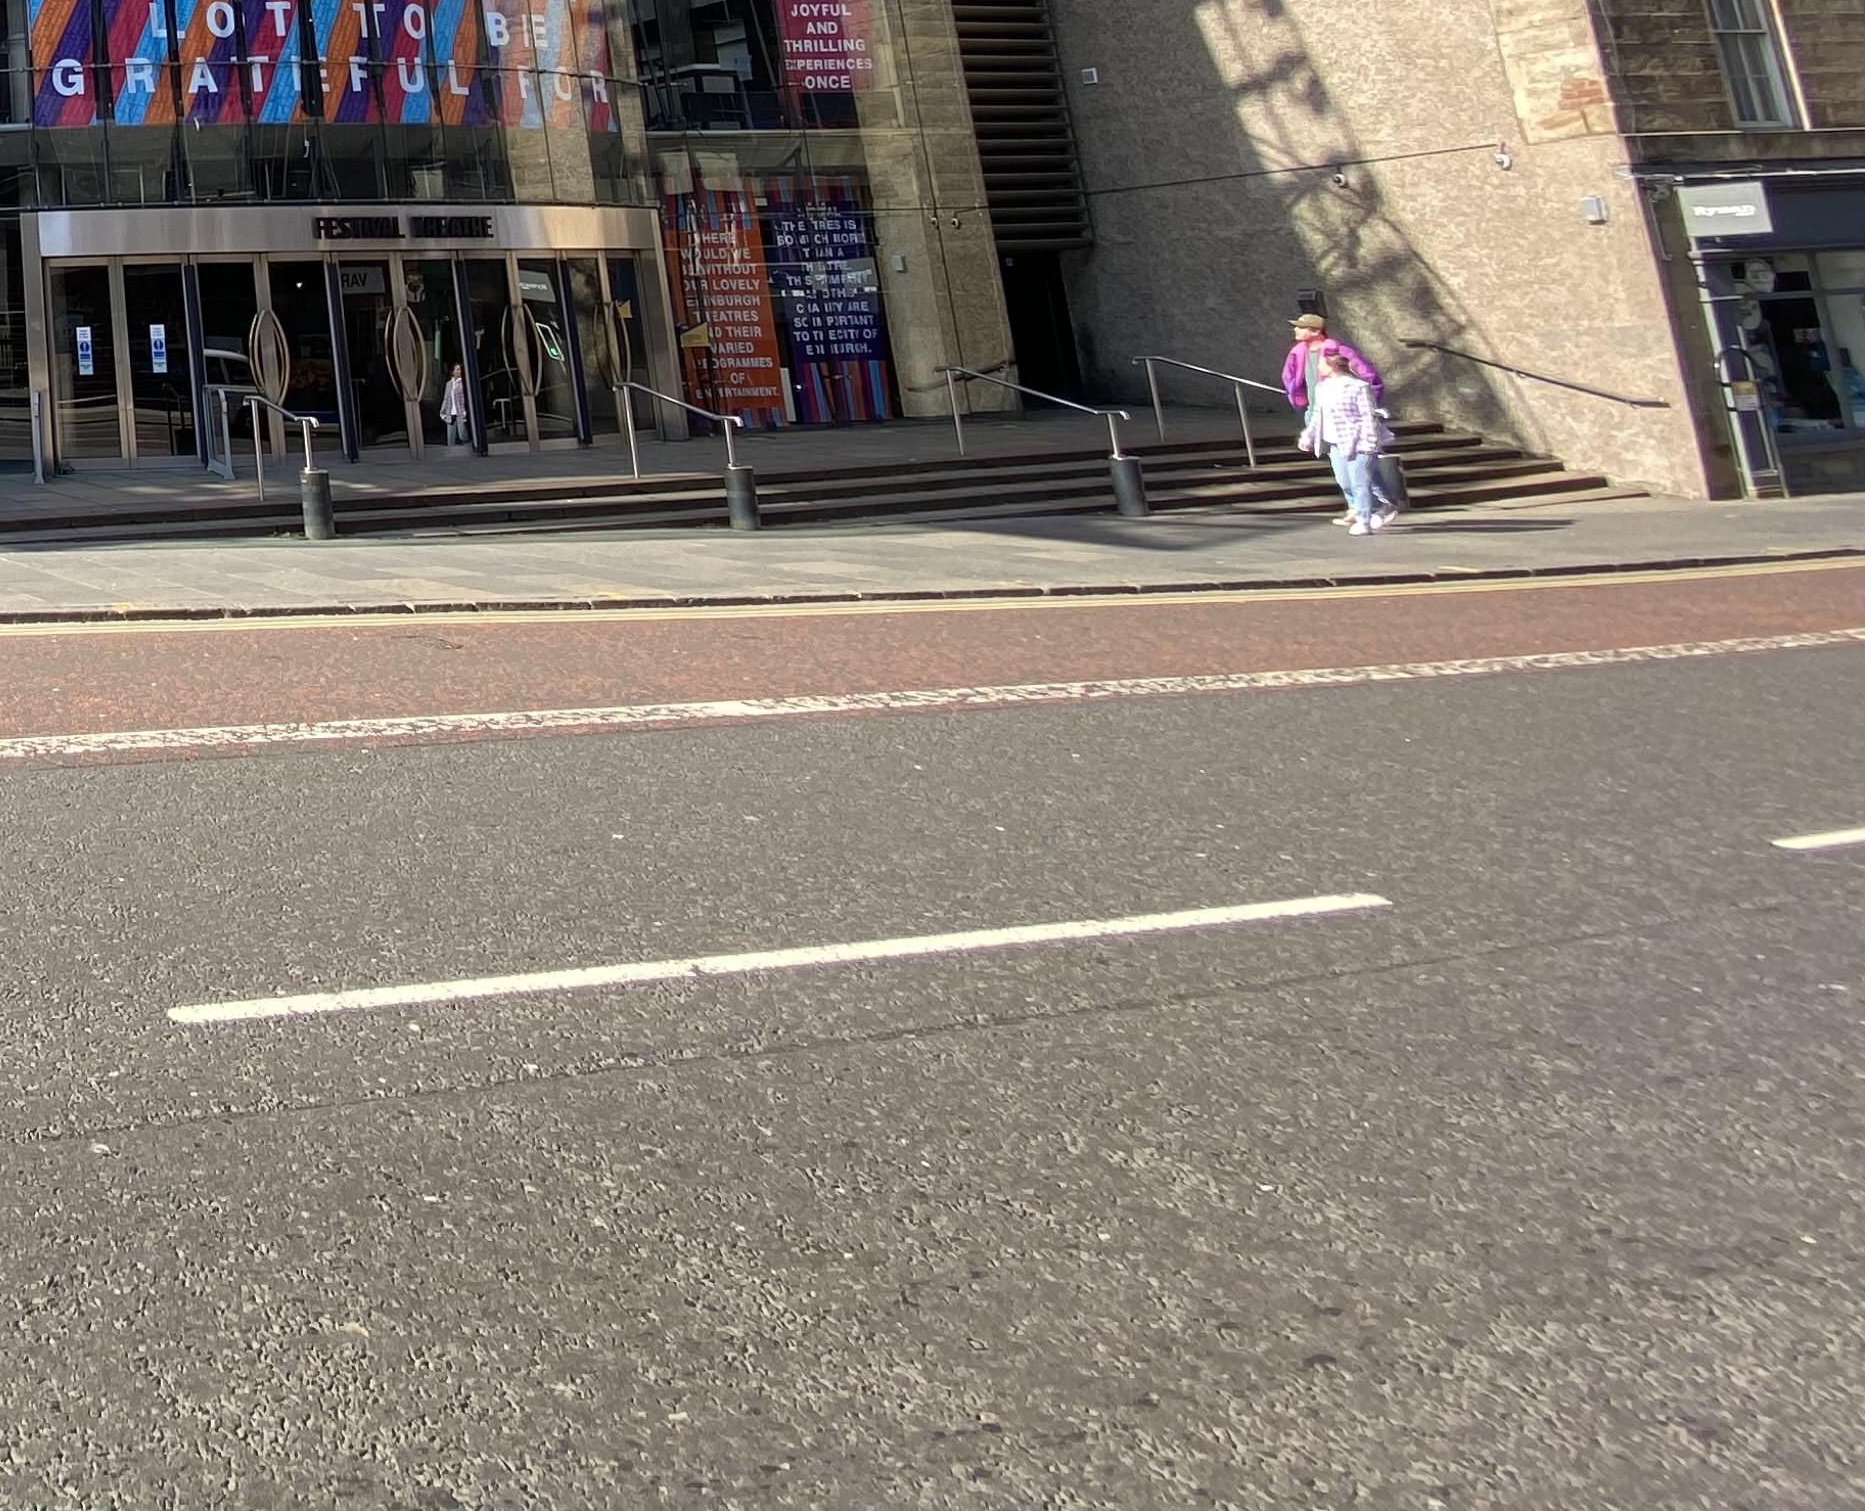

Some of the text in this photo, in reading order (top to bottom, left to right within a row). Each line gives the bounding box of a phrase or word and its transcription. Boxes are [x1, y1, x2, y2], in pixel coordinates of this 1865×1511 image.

[151, 0, 549, 50] LOT TO BE
[806, 22, 837, 34] AND
[52, 56, 608, 105] GRATEFUL FOR
[804, 75, 850, 89] ONCE
[713, 280, 760, 290] LOVELY
[729, 327, 762, 337] THEIR
[730, 373, 745, 384] OF
